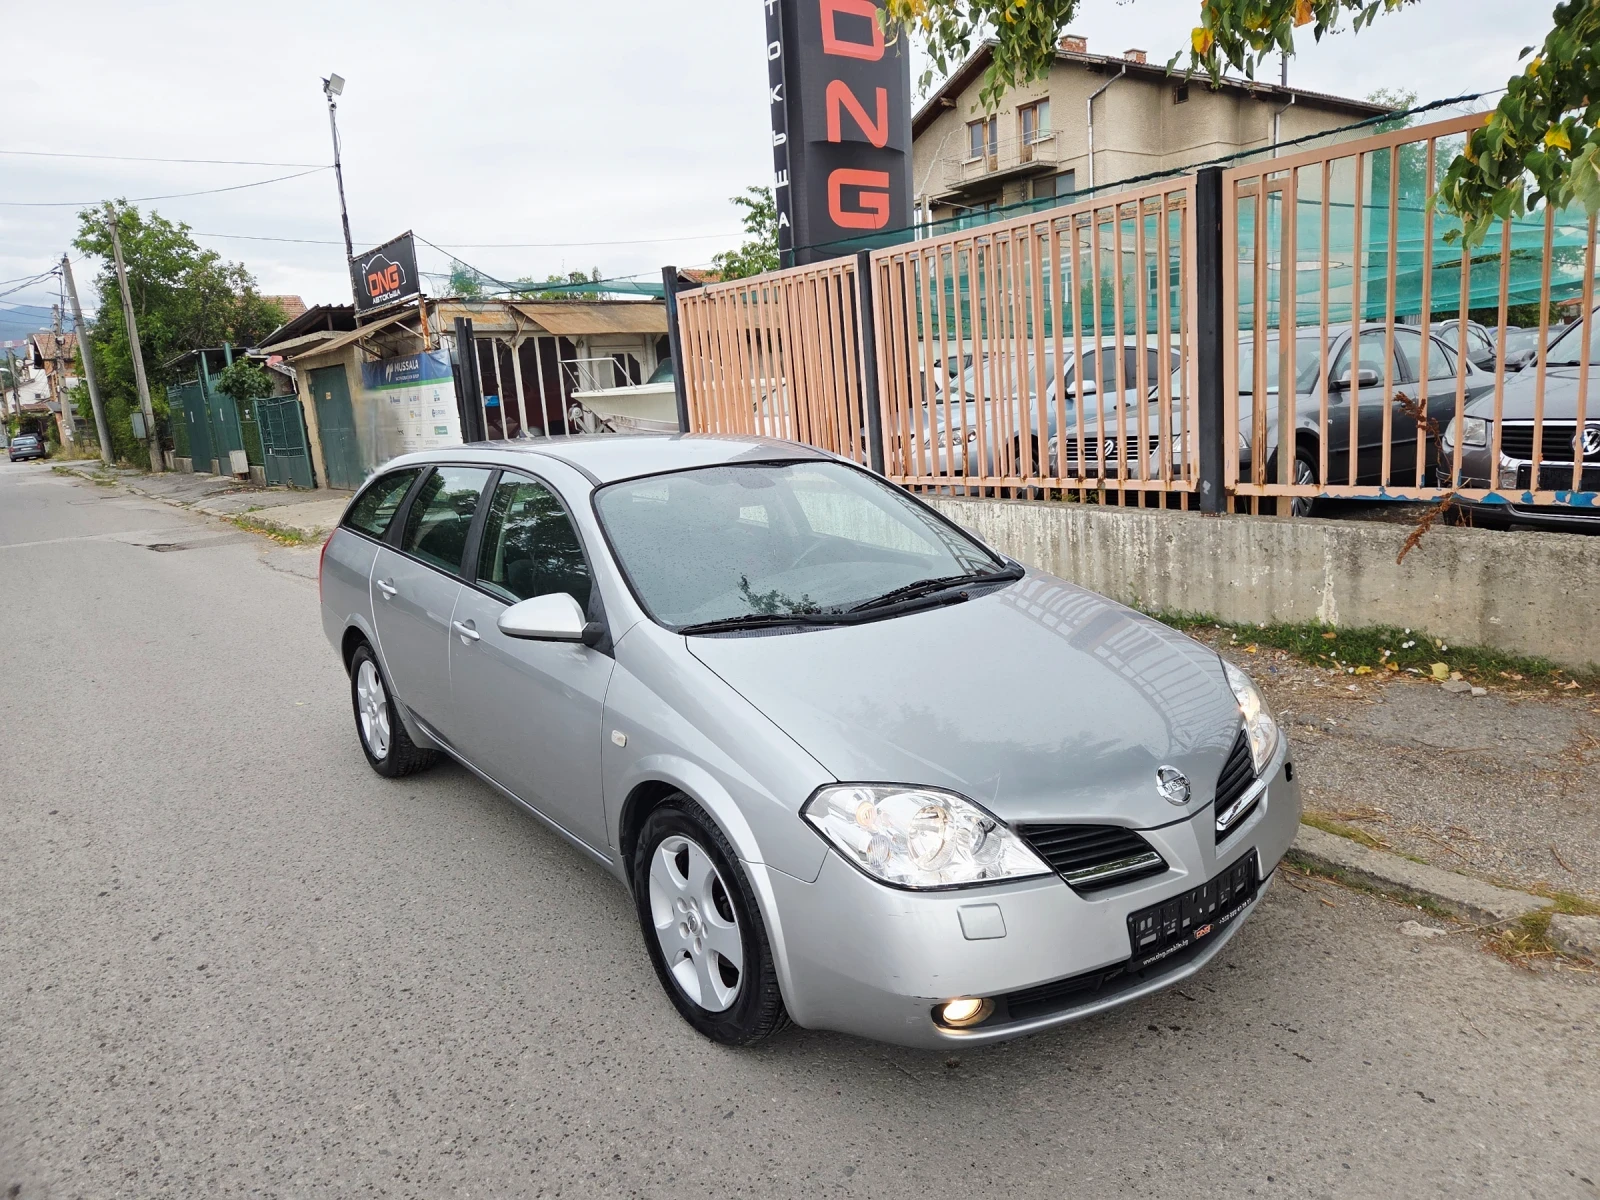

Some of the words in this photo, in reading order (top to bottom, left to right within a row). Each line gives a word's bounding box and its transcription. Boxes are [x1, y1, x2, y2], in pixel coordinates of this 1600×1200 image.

[819, 0, 890, 229] DNG
[368, 264, 400, 297] DNG
[394, 359, 419, 373] MUSSALA
